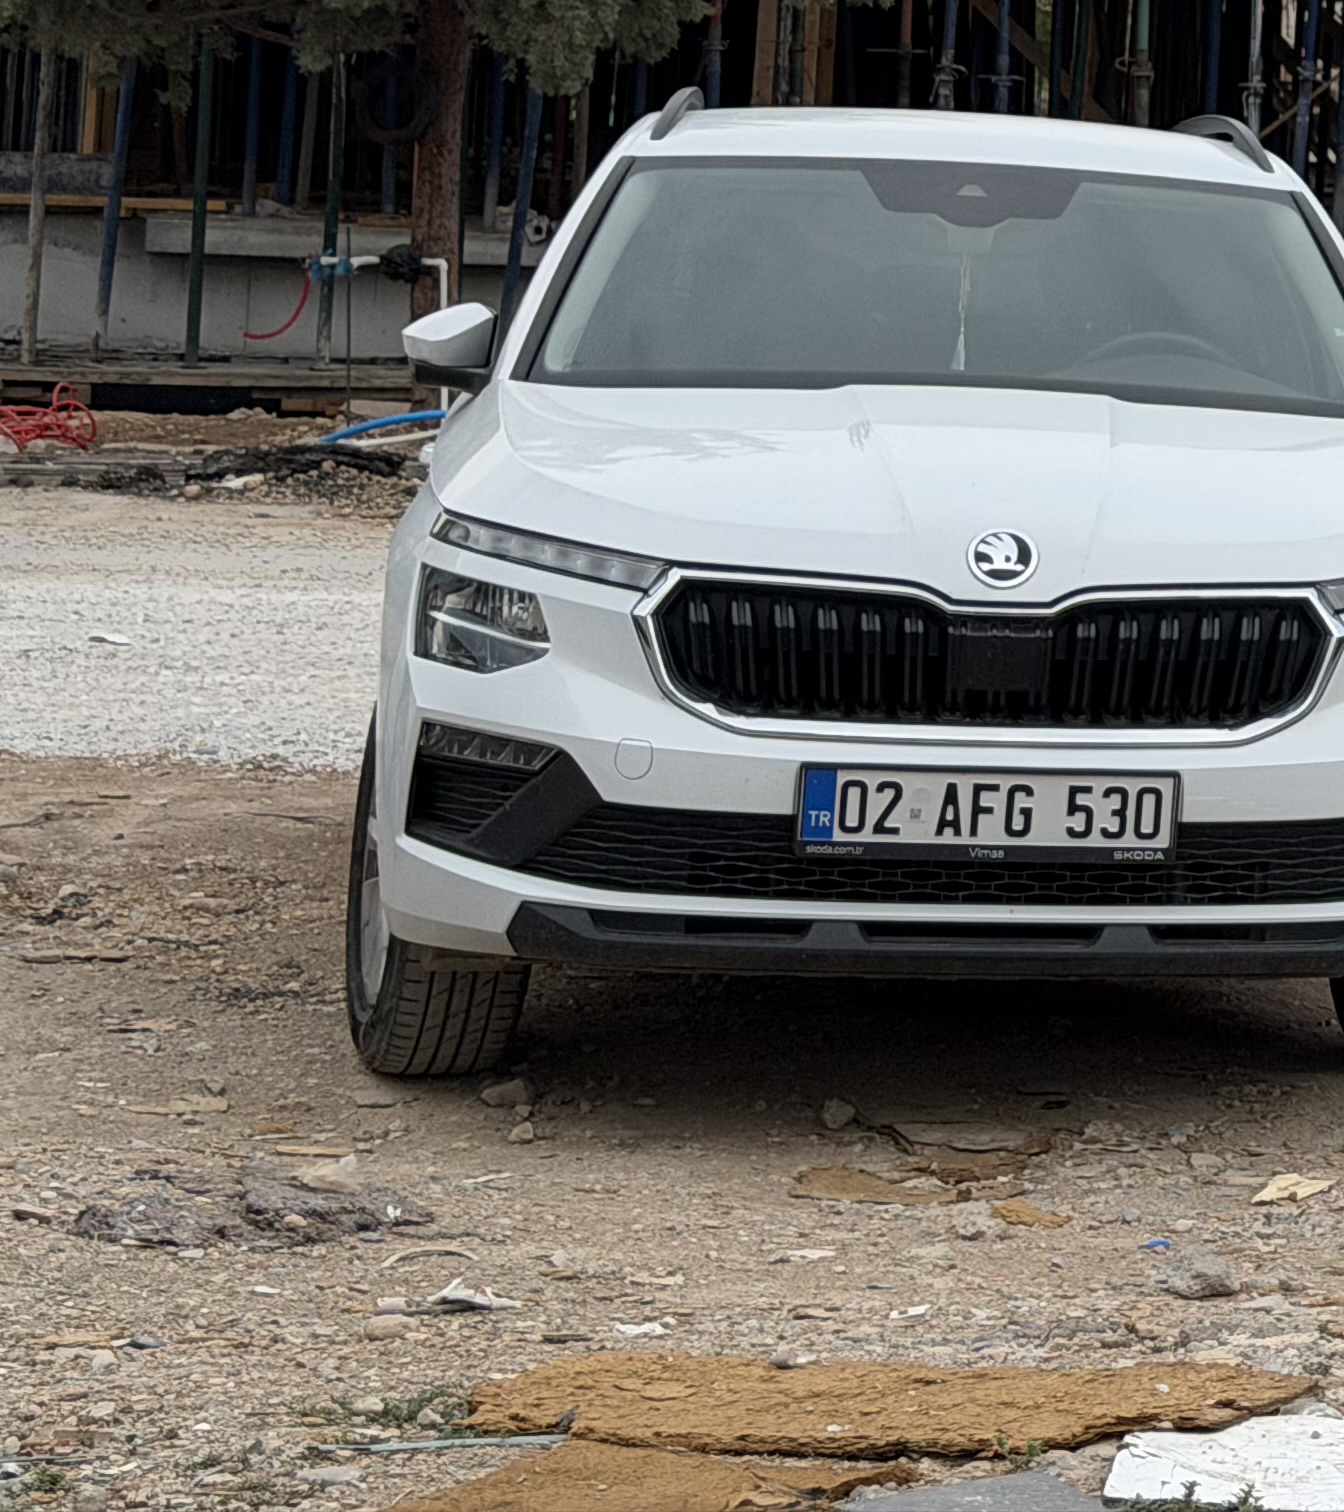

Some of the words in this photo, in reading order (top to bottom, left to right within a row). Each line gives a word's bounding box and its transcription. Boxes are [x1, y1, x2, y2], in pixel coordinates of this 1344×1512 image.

[808, 810, 831, 827] TR
[838, 779, 904, 836] 02
[934, 782, 1035, 838] AFG
[1065, 784, 1163, 841] 530
